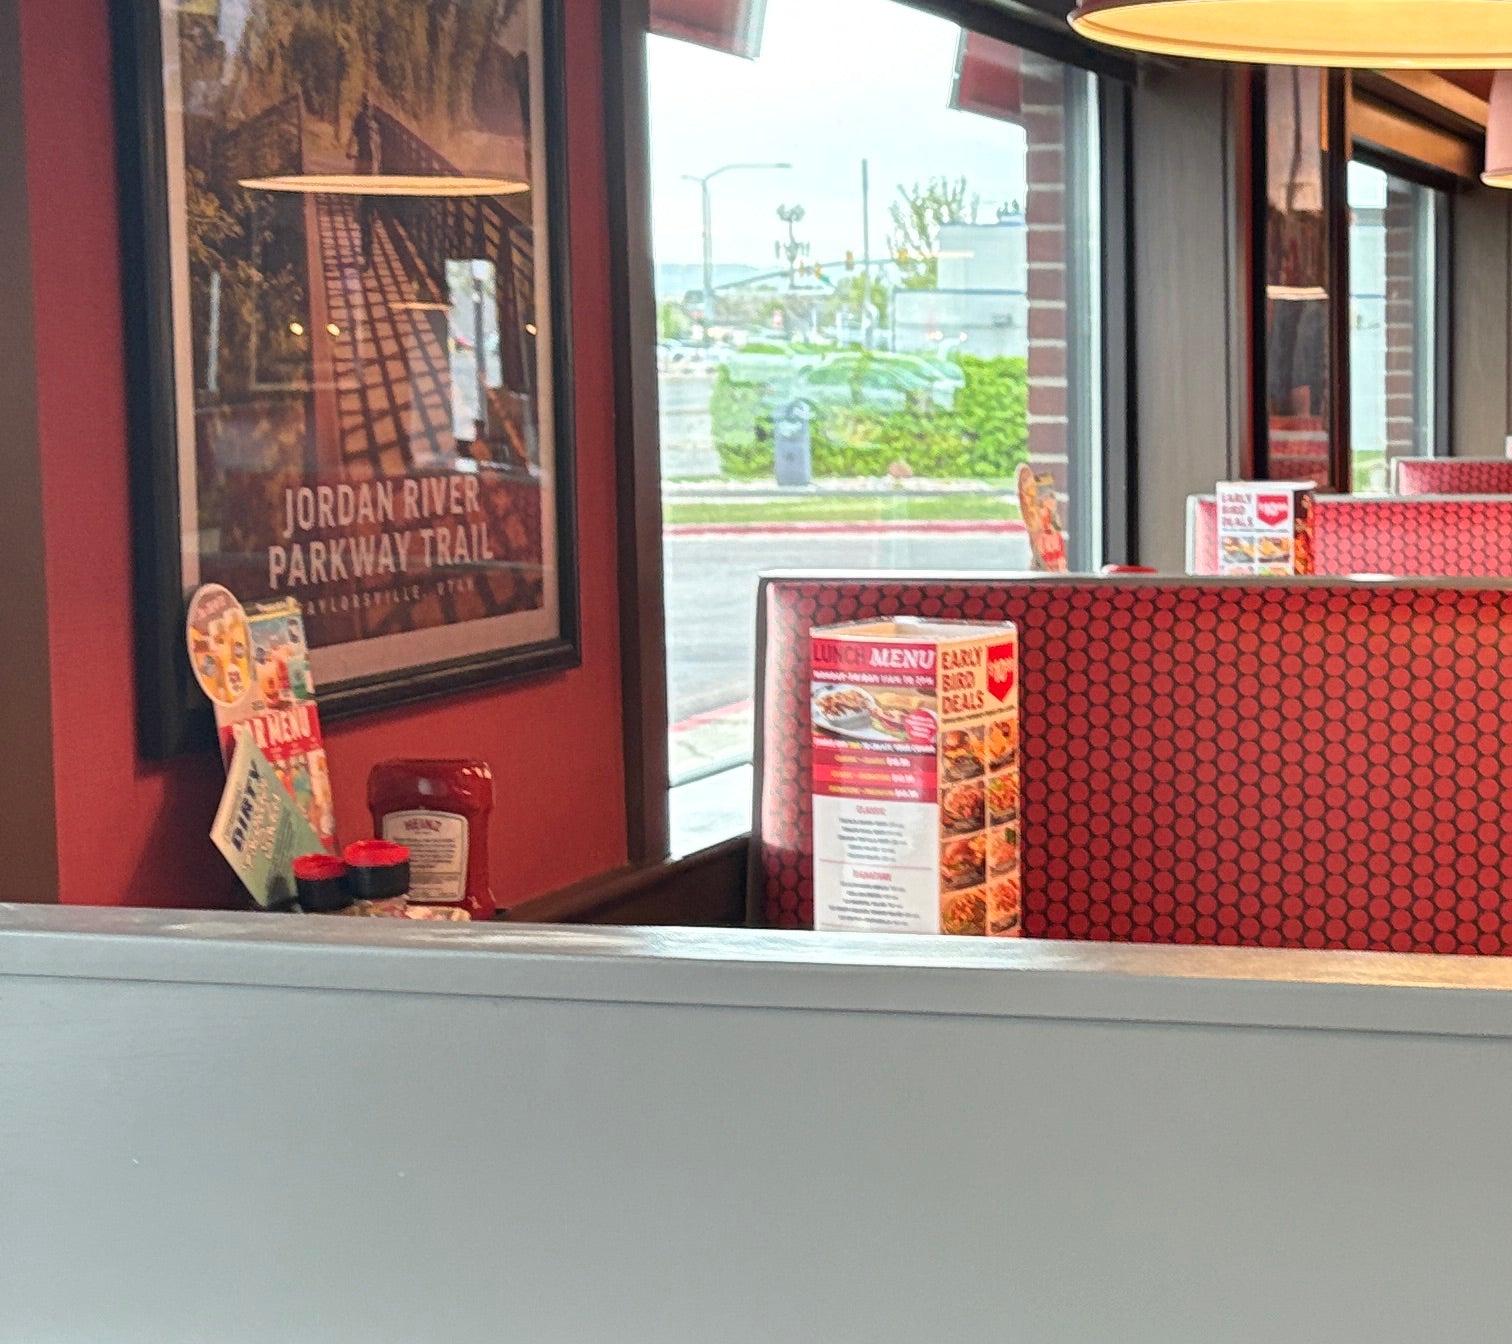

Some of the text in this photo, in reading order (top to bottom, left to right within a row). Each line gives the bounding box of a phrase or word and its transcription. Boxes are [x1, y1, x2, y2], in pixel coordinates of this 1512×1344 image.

[283, 474, 480, 539] JORDAN RIVER
[268, 521, 493, 590] PARKWAY TRAIL
[813, 642, 936, 670] LUNCH MENU
